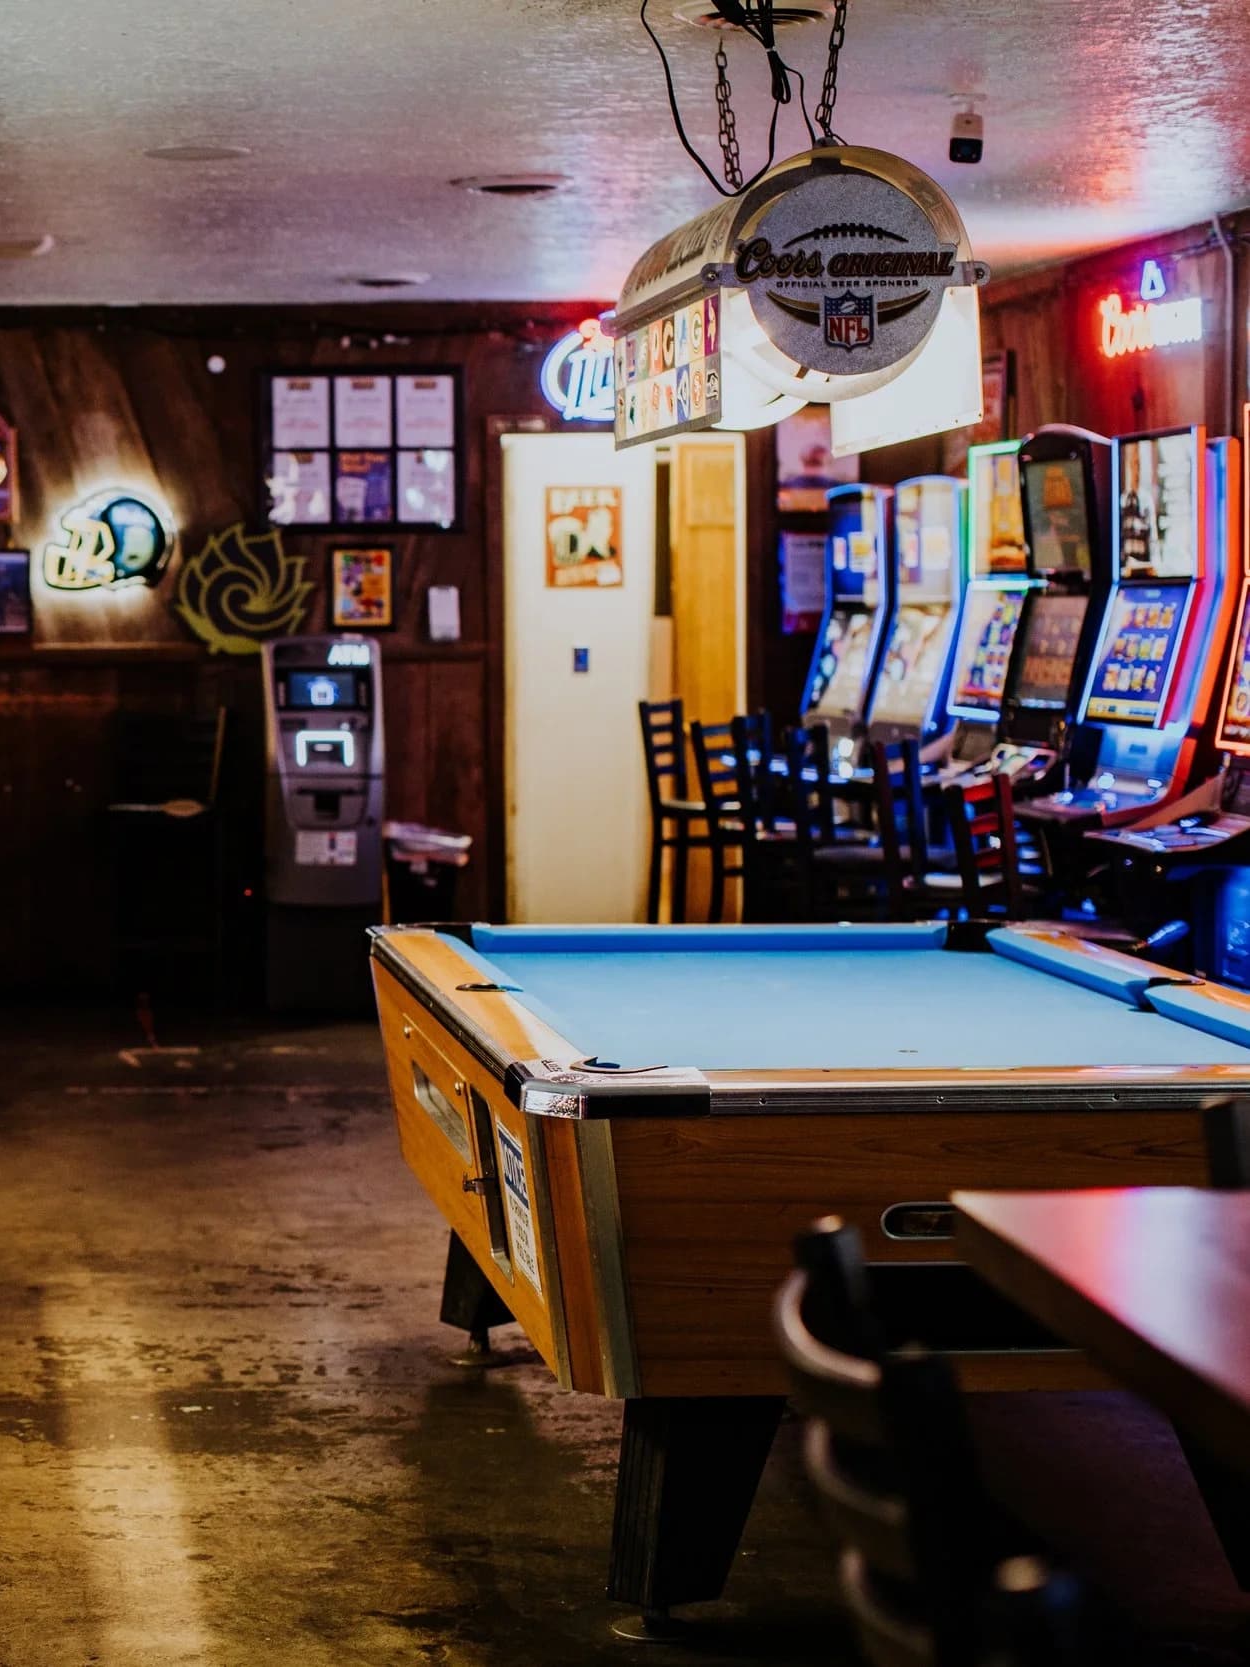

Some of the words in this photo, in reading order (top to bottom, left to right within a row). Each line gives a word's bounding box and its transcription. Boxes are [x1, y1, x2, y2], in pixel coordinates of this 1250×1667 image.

[734, 237, 822, 285] Coors
[826, 251, 956, 278] ORIGINAL
[776, 280, 827, 289] OFFICIAL
[831, 280, 860, 288] BEER
[865, 279, 919, 288] SPONSOR
[827, 315, 870, 347] NFL
[327, 643, 371, 666] ATM
